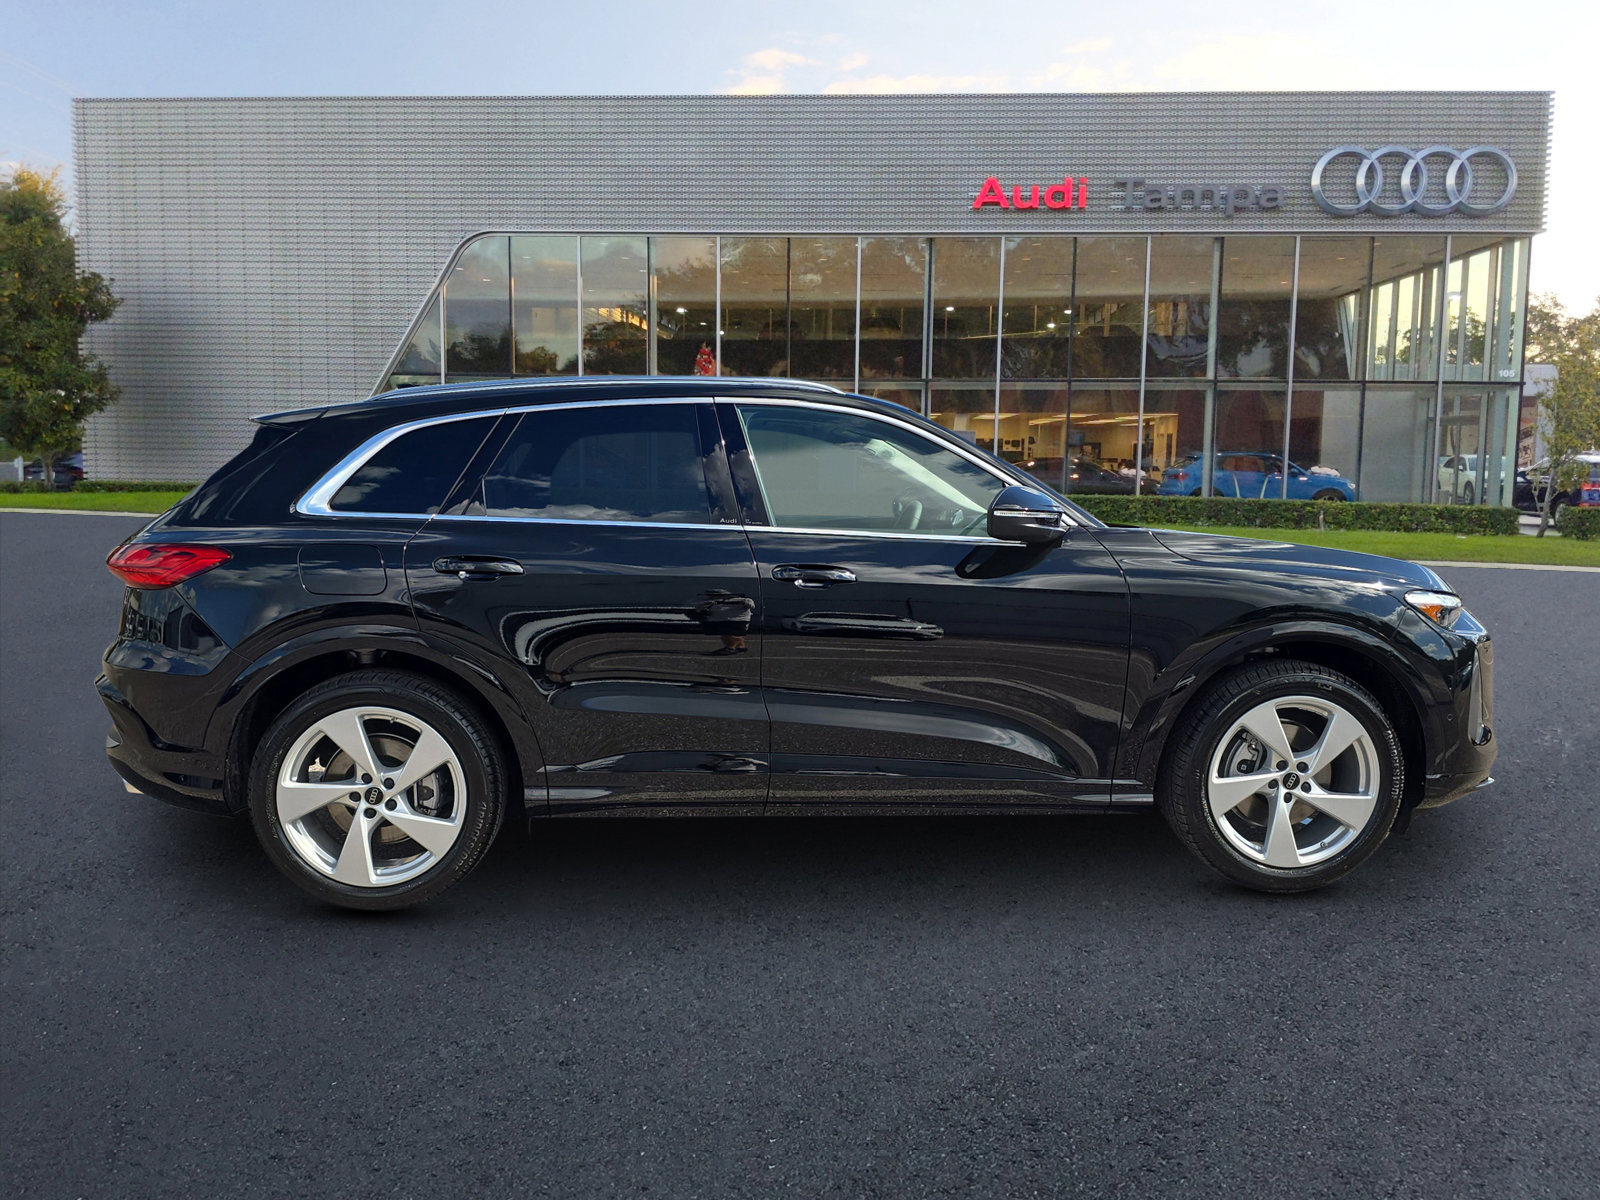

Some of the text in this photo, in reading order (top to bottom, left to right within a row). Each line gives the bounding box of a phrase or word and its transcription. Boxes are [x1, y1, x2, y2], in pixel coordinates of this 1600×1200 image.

[972, 176, 1285, 218] Audi Tampa
[1499, 369, 1515, 378] 105
